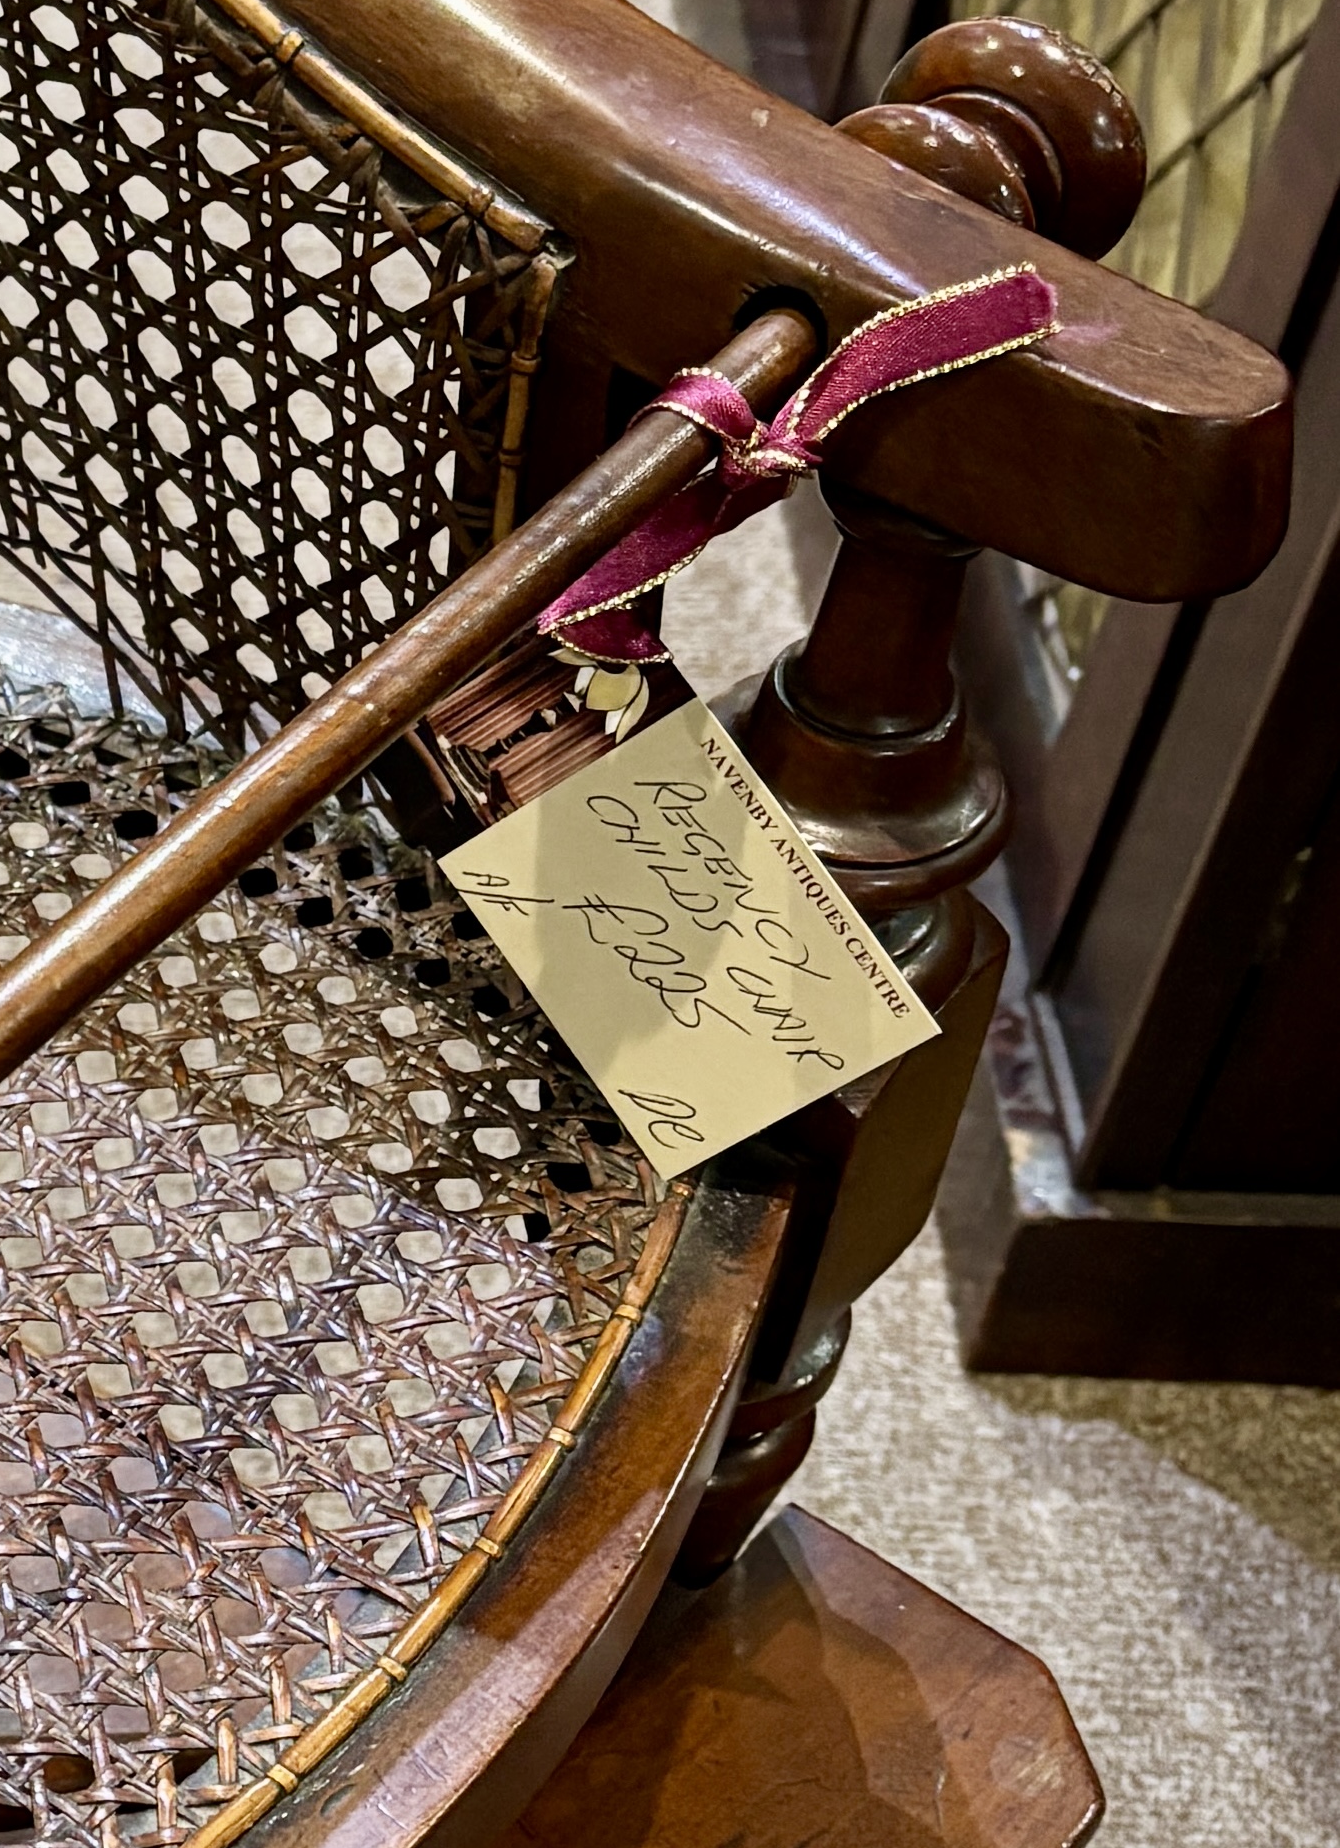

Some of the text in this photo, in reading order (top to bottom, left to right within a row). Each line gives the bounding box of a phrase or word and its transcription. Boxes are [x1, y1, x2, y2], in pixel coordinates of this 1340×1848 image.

[561, 893, 751, 1035] £225
[586, 795, 844, 1070] CHILDS CHAIR
[633, 781, 831, 980] REGENCY
[700, 737, 911, 1019] NAVENBY ANTIQUES CENTRE
